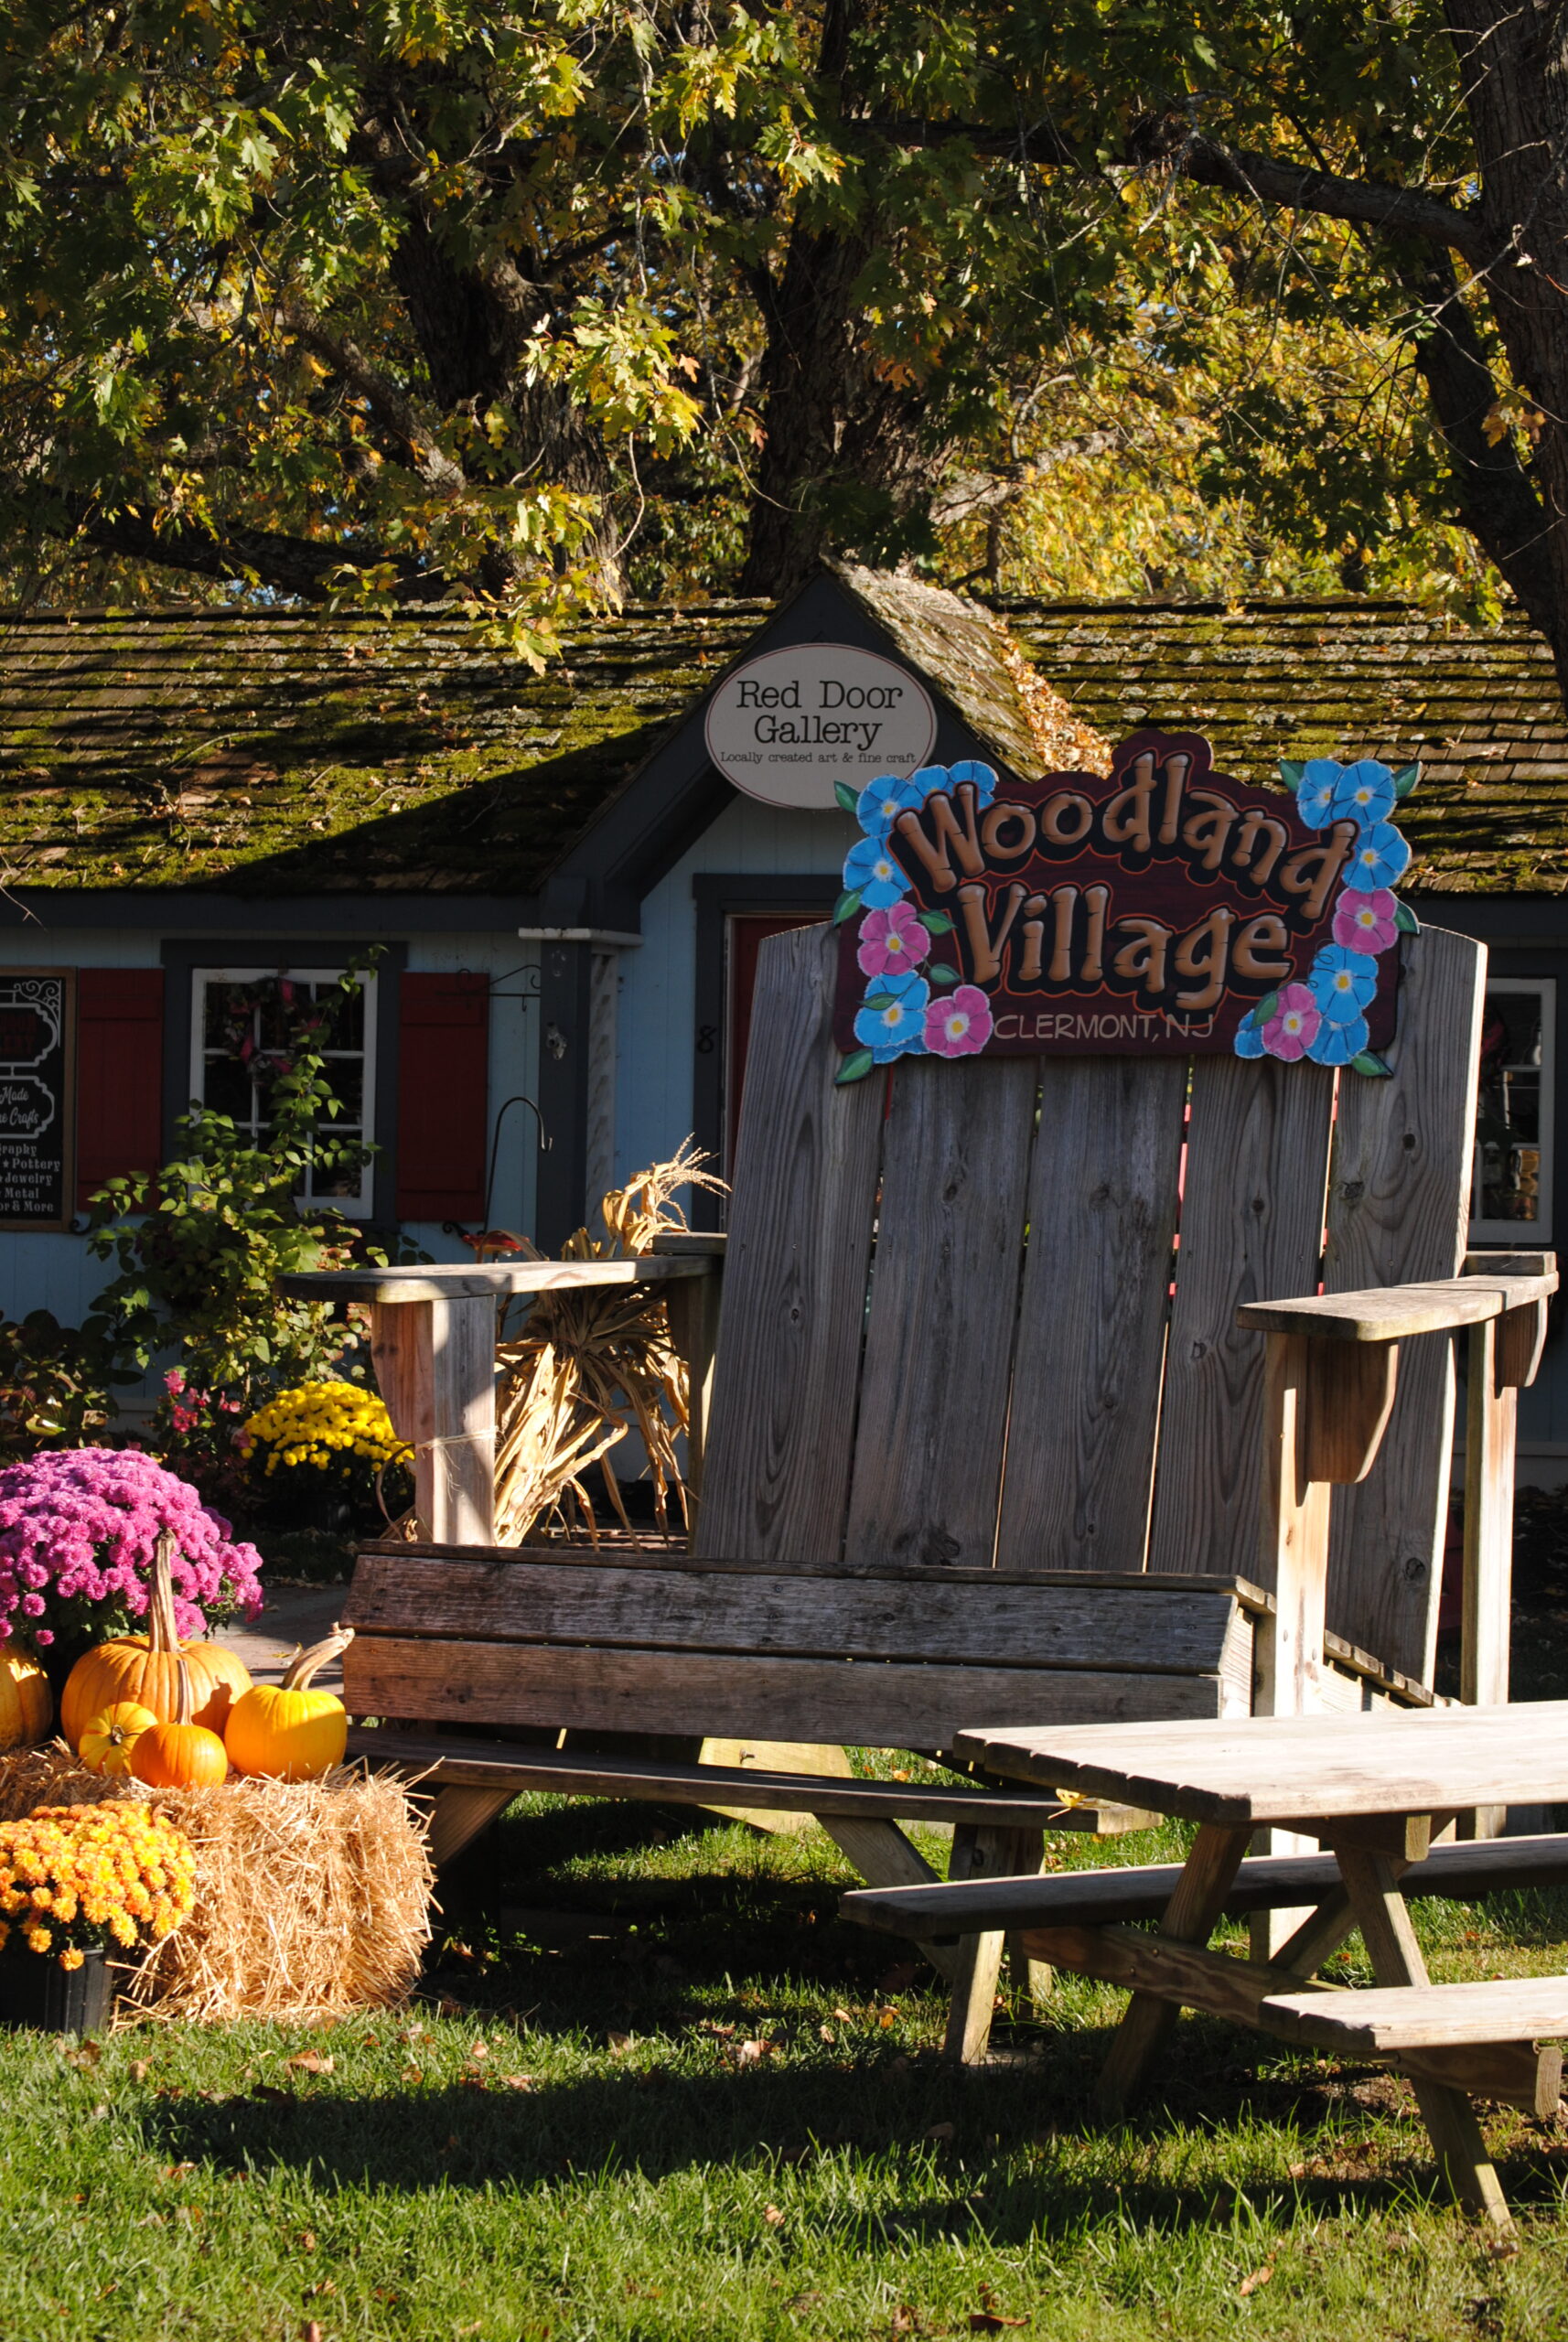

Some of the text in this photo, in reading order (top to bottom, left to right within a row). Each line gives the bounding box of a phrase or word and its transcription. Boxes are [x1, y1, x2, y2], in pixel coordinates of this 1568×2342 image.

[736, 680, 903, 709] Red Door
[755, 714, 883, 752] Gallery
[720, 752, 917, 765] Locally created art & fine craft
[893, 749, 1359, 924] Woodland
[955, 882, 1293, 1013] Village
[9, 1106, 39, 1130] Crafts
[12, 1157, 61, 1173] Pottery
[5, 1171, 53, 1186] Jewelry
[5, 1187, 39, 1199] Metal
[12, 1199, 21, 1212] &
[23, 1199, 54, 1213] More
